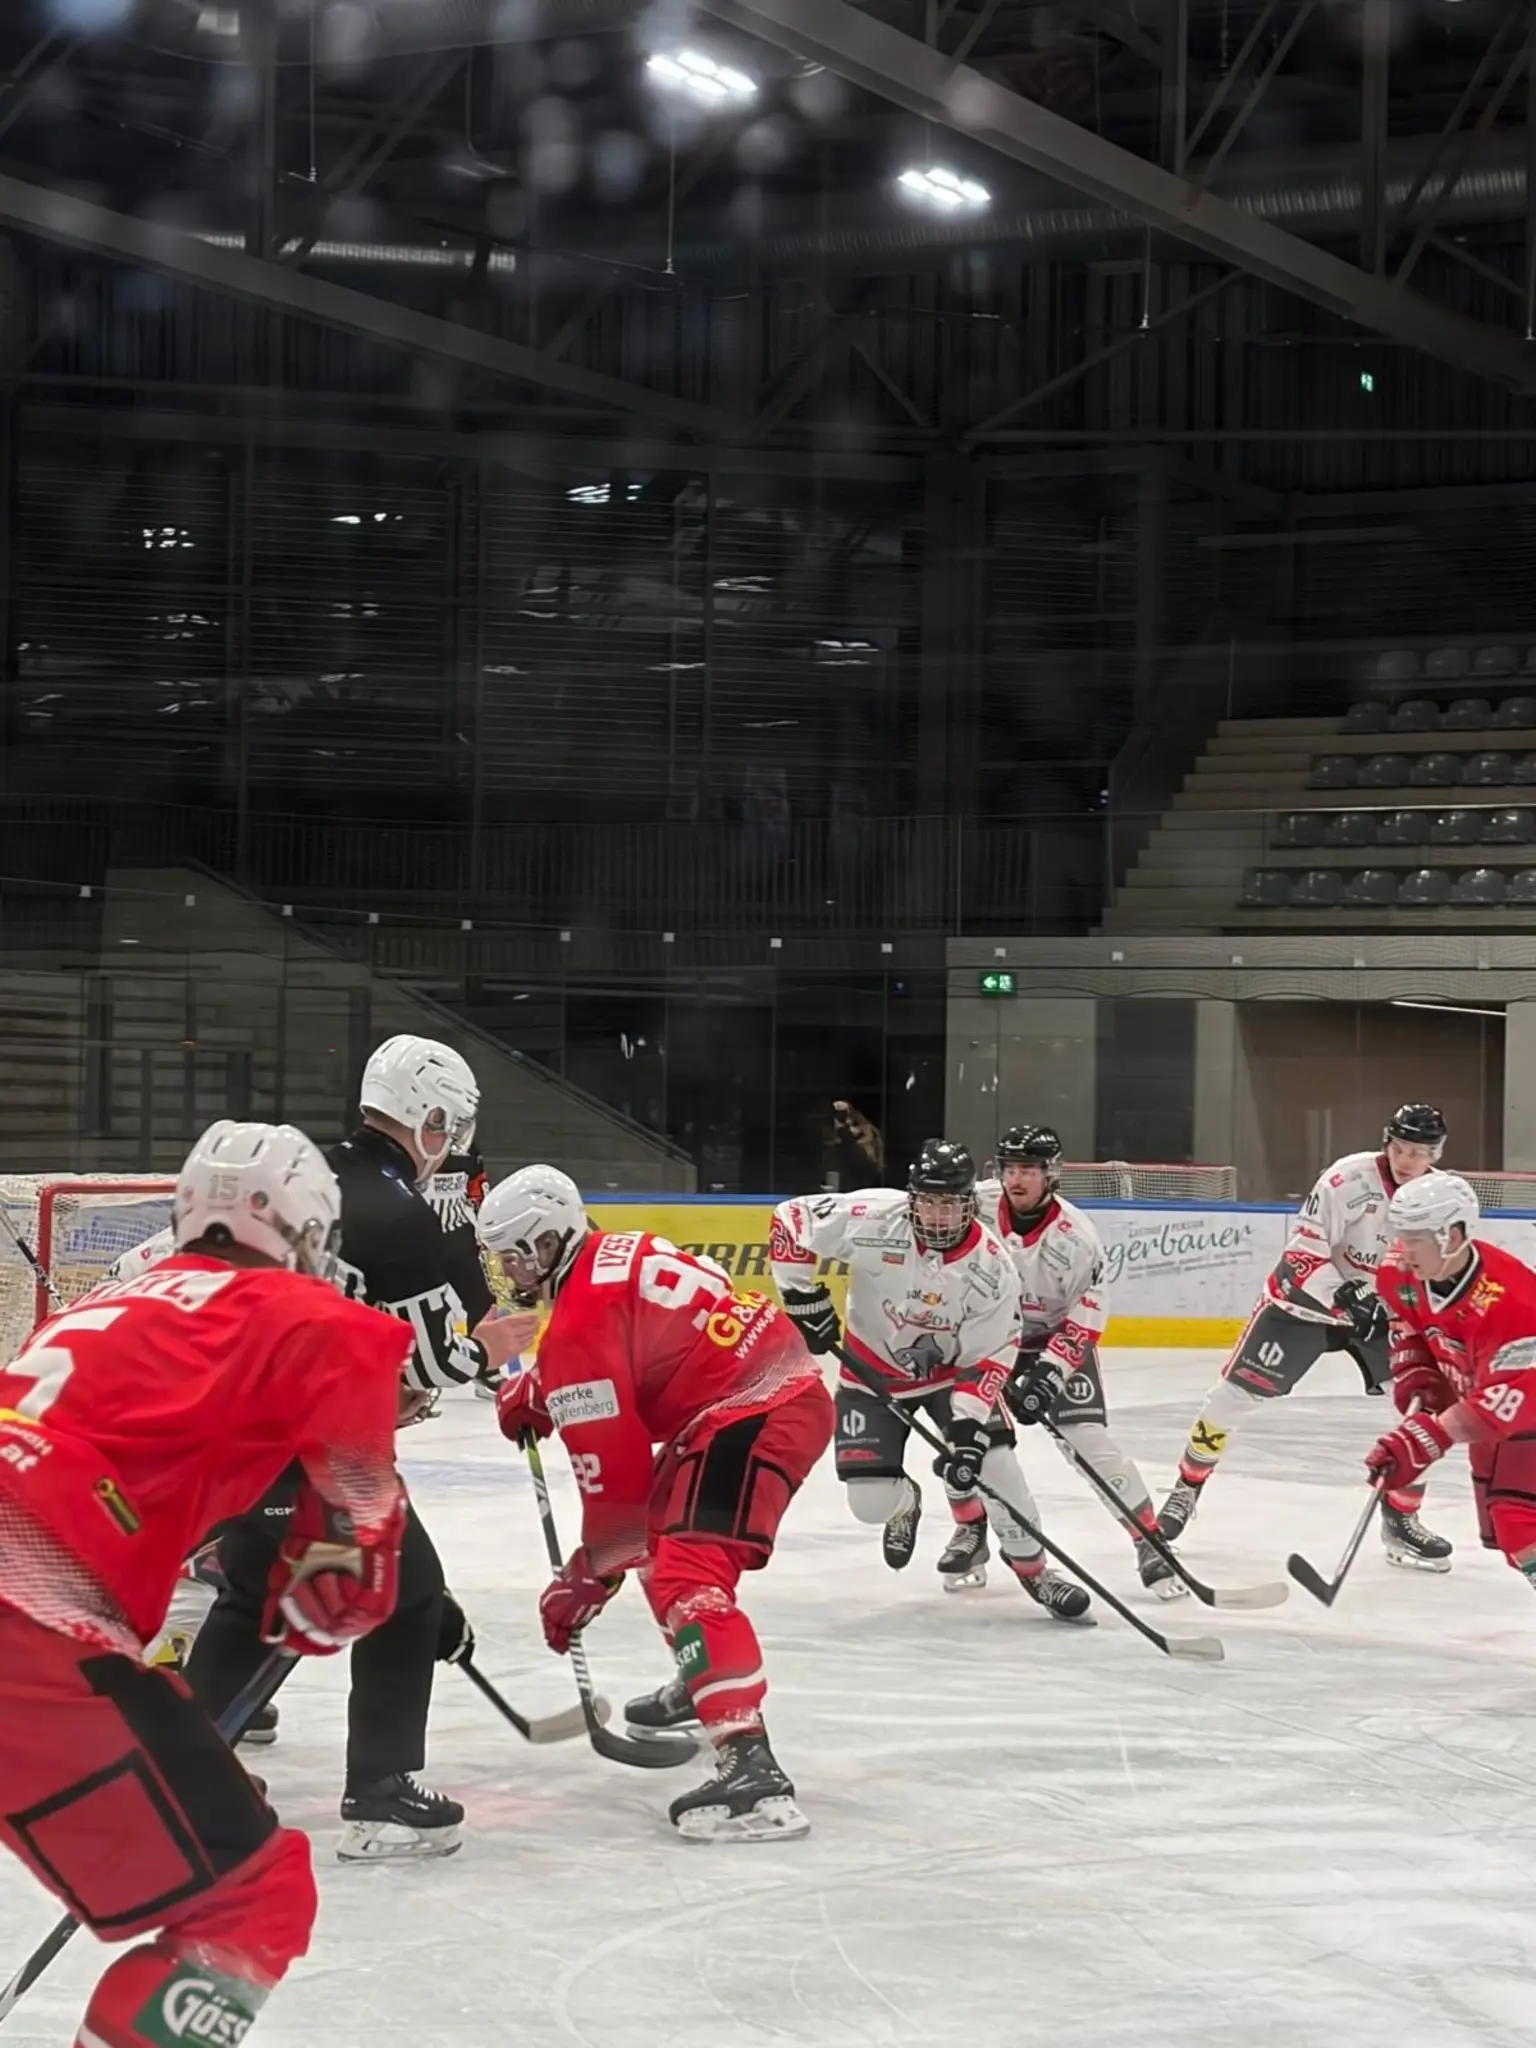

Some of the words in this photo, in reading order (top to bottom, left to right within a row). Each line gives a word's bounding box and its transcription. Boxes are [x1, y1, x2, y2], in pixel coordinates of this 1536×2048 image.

[207, 1174, 240, 1201] 15
[1105, 1223, 1252, 1284] gerbauer
[1477, 1383, 1525, 1423] 98
